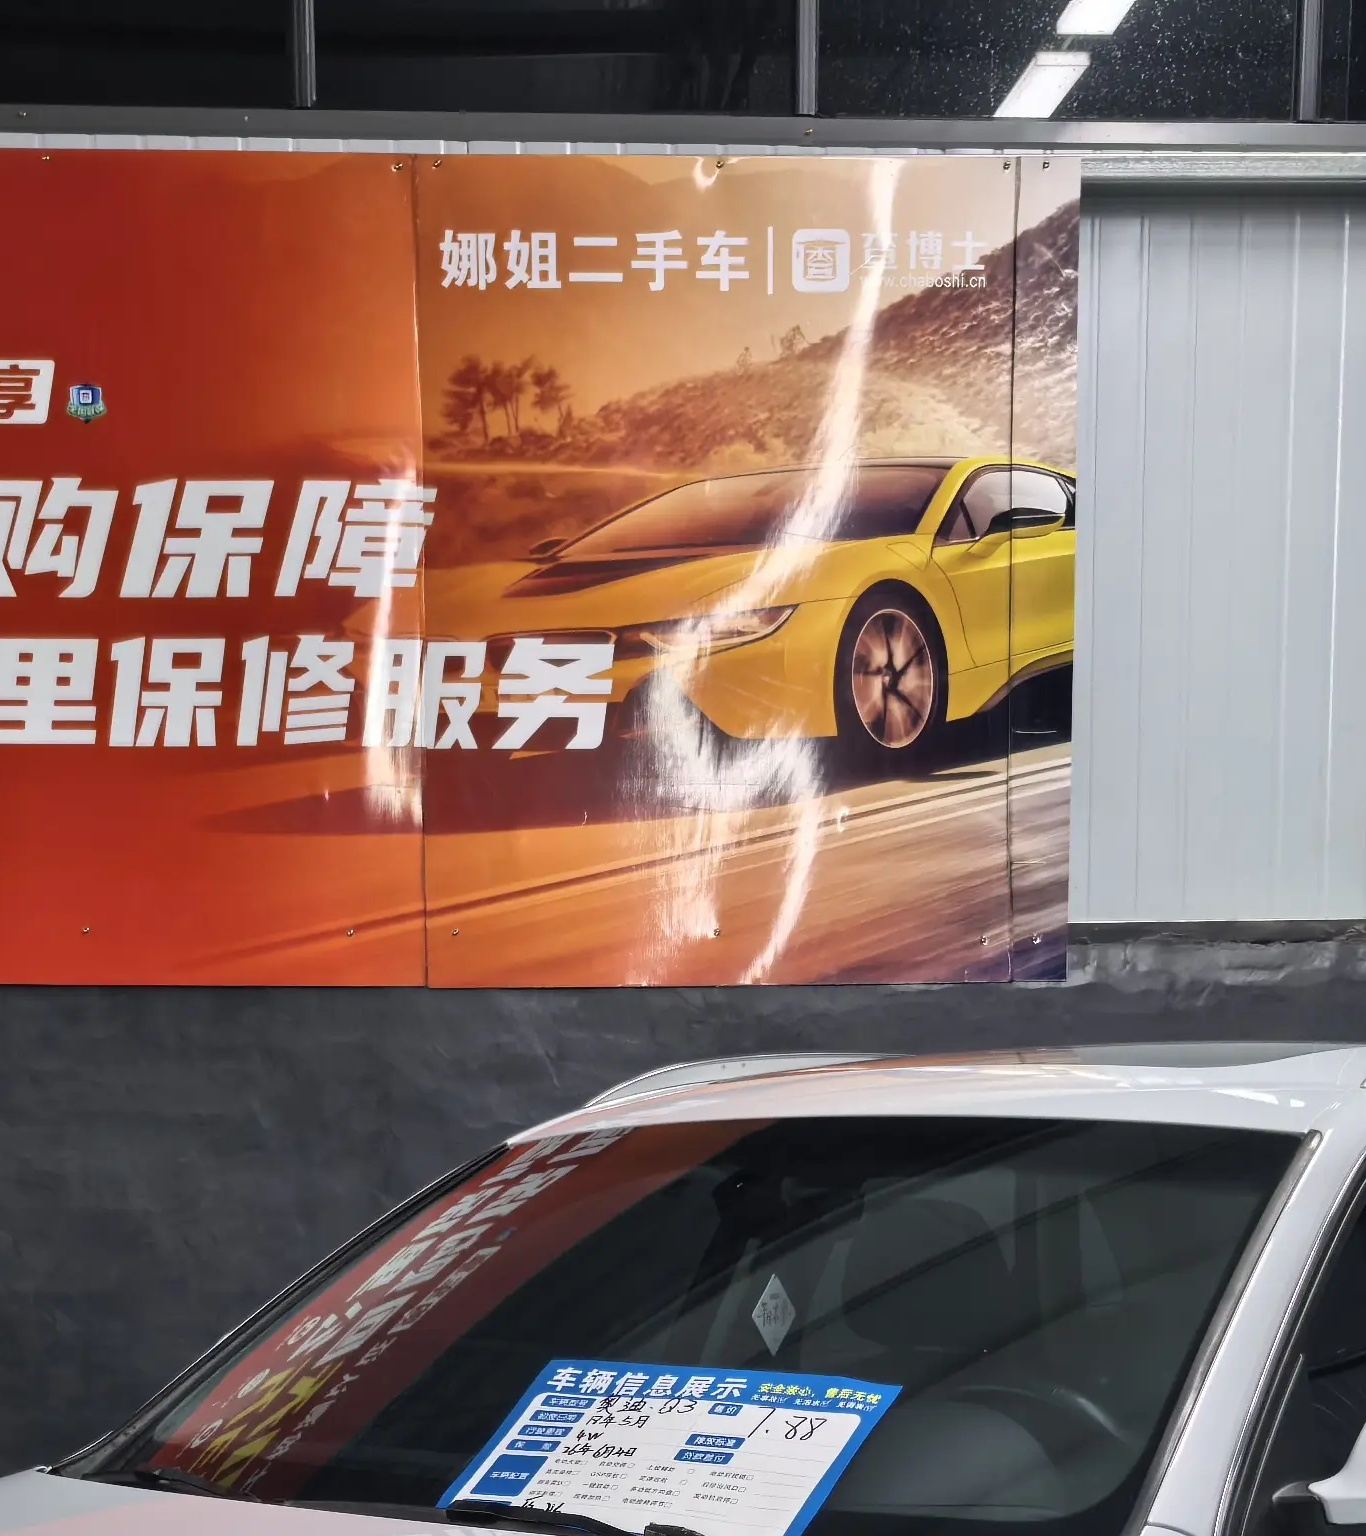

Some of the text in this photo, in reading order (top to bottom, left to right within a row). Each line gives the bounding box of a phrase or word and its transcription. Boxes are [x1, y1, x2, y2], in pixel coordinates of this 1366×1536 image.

[439, 229, 749, 293] 娜姐二手车
[860, 230, 988, 270] 查博士
[547, 1366, 747, 1399] 车辆信息展示
[713, 1404, 737, 1414] 售价
[748, 1406, 827, 1441] 7.88
[489, 1471, 530, 1481] 车辆配置
